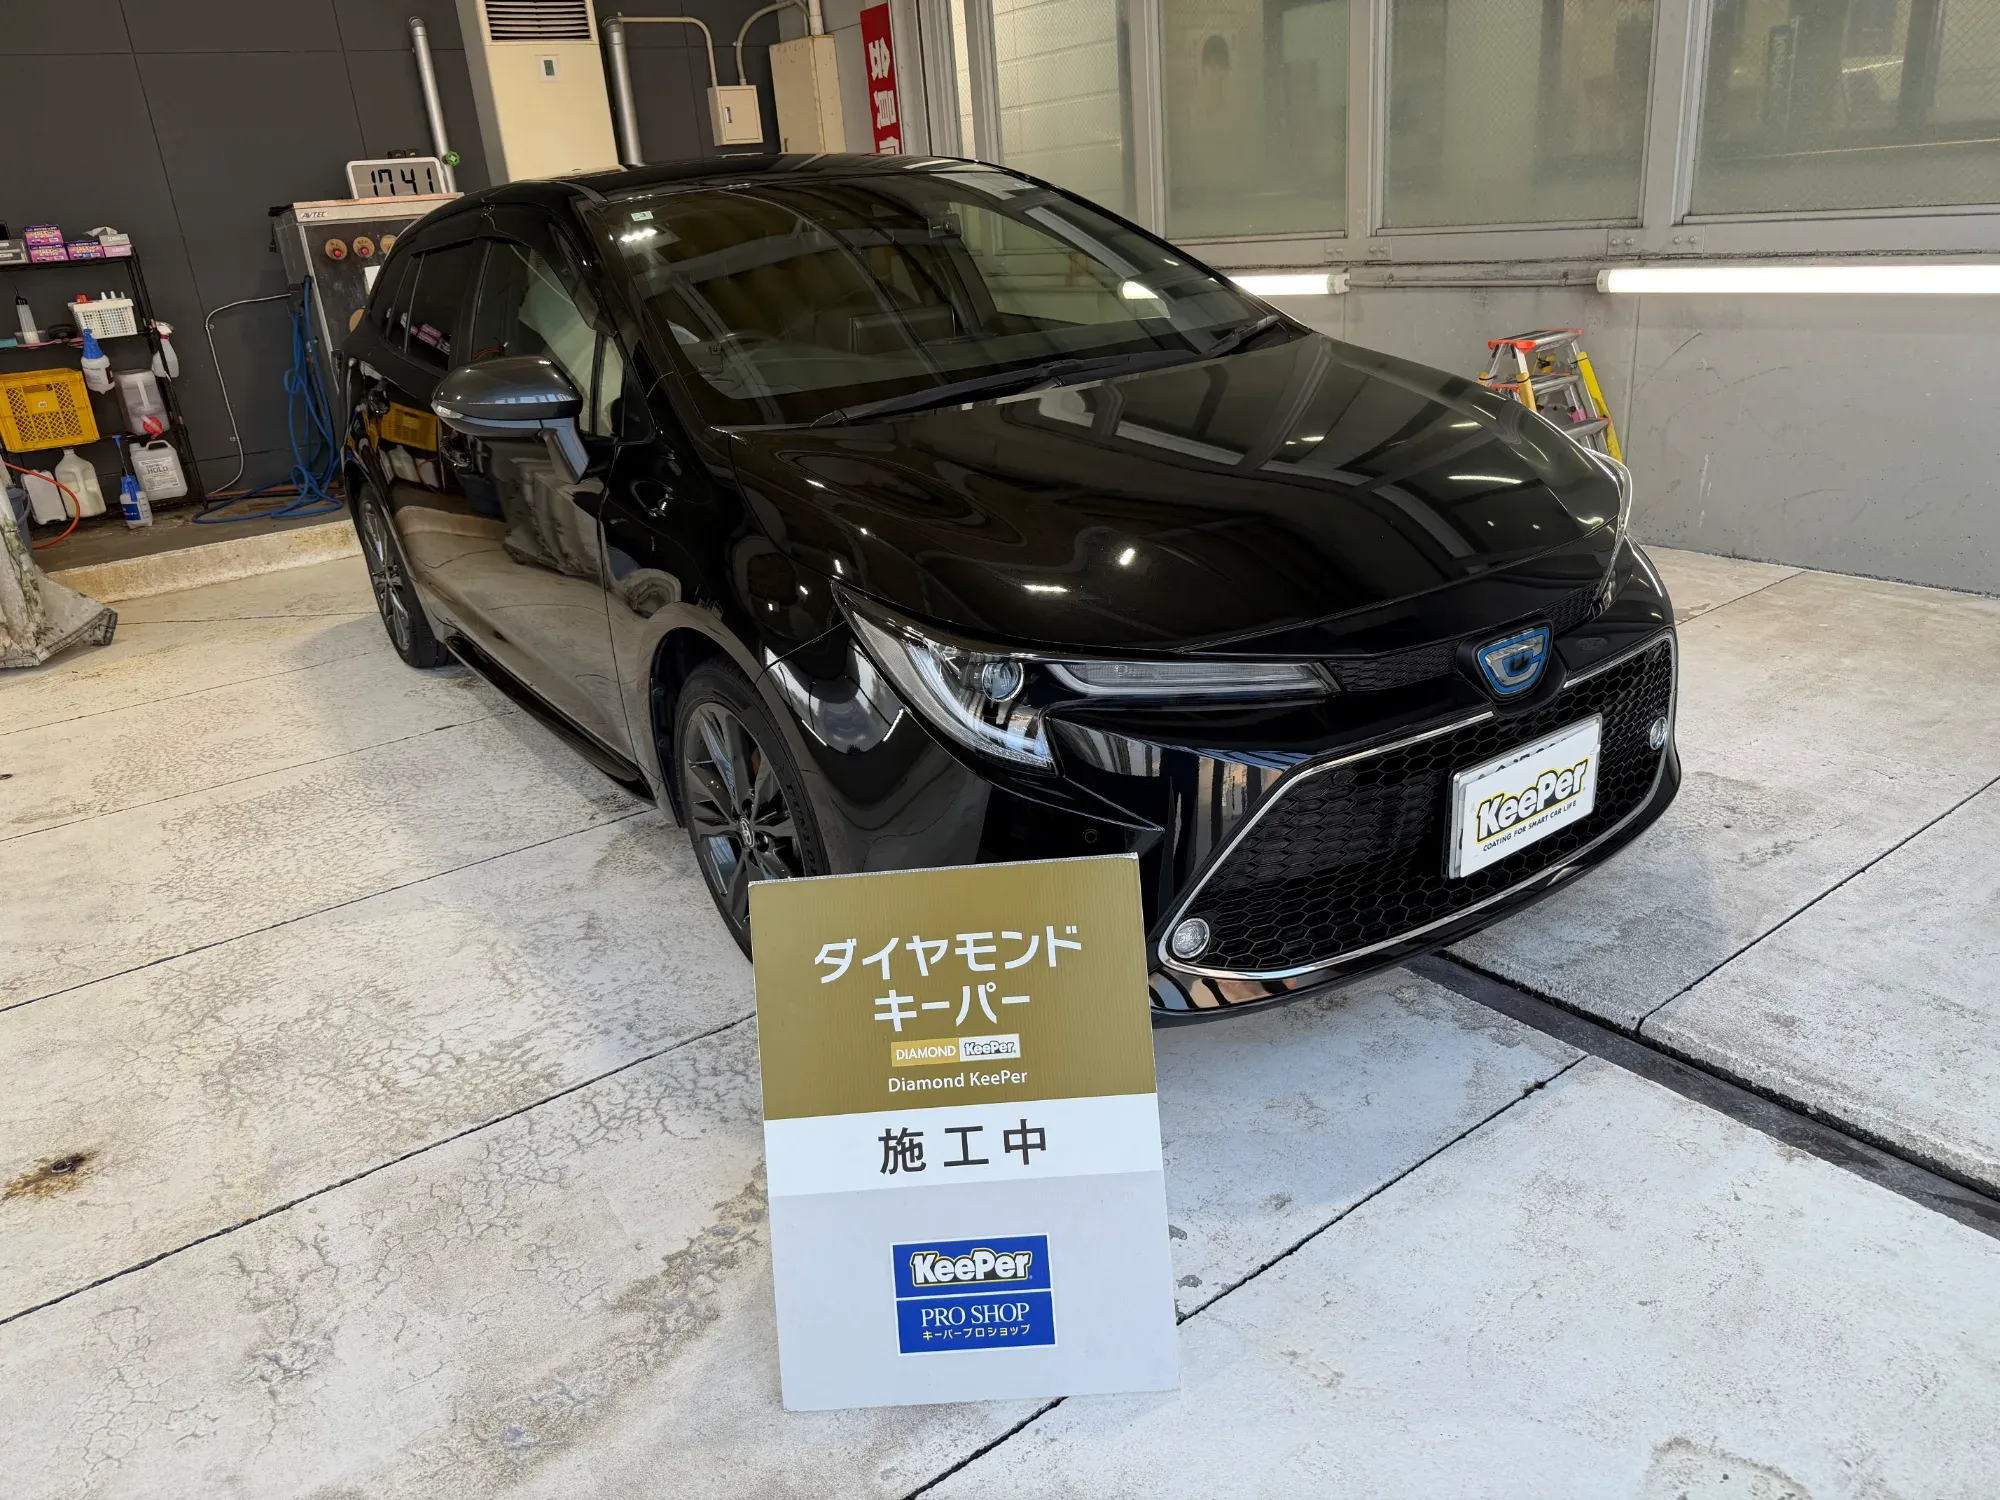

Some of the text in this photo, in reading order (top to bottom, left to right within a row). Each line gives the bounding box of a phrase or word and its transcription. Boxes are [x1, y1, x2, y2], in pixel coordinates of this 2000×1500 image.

[147, 466, 168, 474] HOLD
[1477, 758, 1588, 842] KeePer
[1483, 800, 1577, 851] COATING FOR SMART CAR LIFE
[814, 925, 1082, 984] ダイヤモンド
[874, 981, 1031, 1032] キーパー
[896, 1040, 1015, 1060] DIAMOND KeePer
[888, 1069, 1028, 1093] Diamond KeePer
[877, 1118, 1047, 1175] 施工中
[910, 1248, 1033, 1287] KeePer
[921, 1302, 1030, 1328] PRO SHOP
